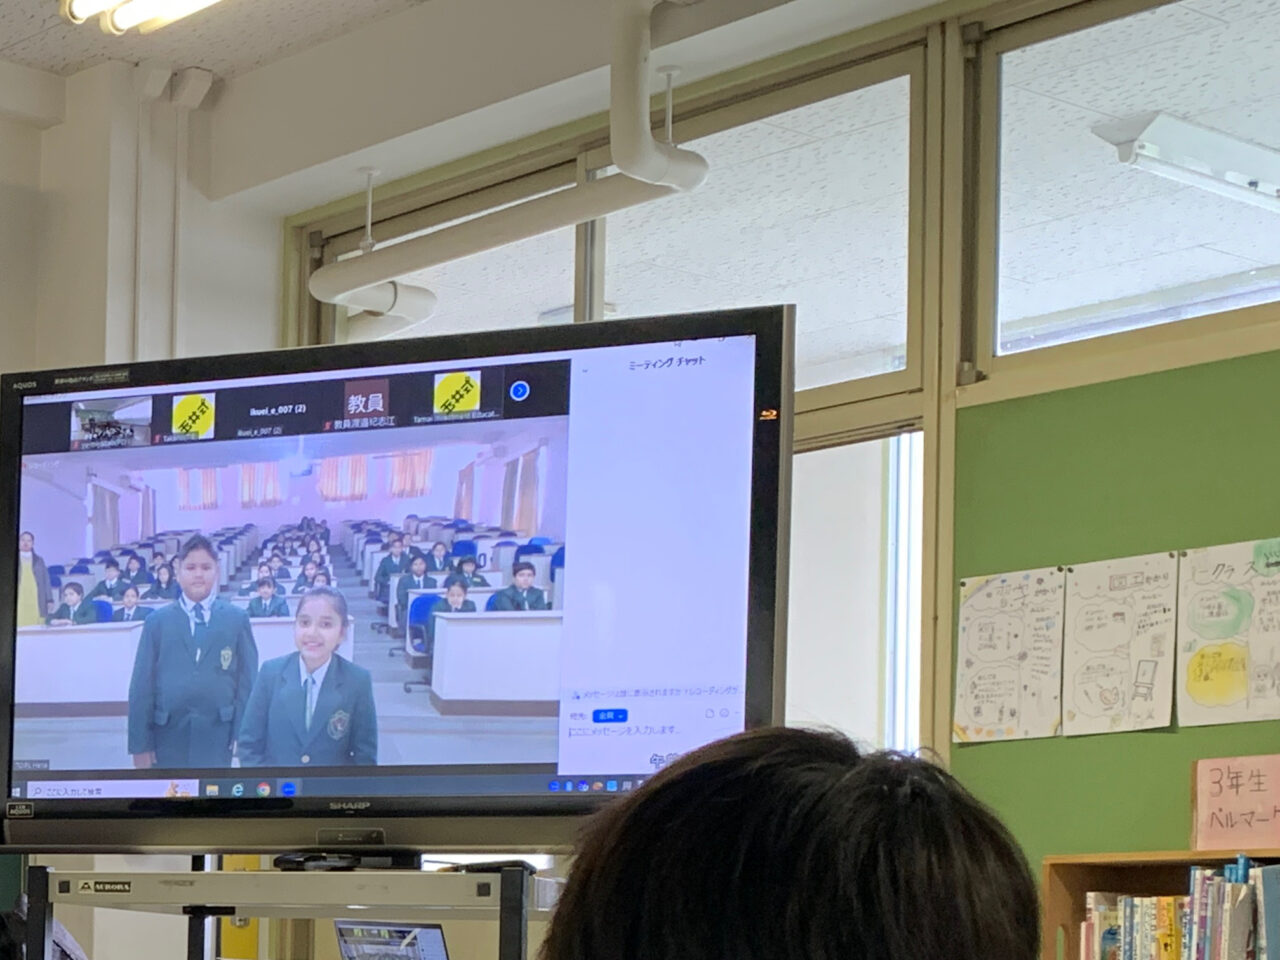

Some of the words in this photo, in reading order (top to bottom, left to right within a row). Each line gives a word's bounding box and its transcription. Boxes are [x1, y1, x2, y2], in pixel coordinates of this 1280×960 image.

[629, 356, 674, 371] ミーティング
[676, 355, 707, 367] チャット
[347, 392, 385, 415] 教員
[1209, 765, 1268, 798] 3年生
[329, 801, 371, 810] SHARP
[94, 883, 132, 892] AURORA
